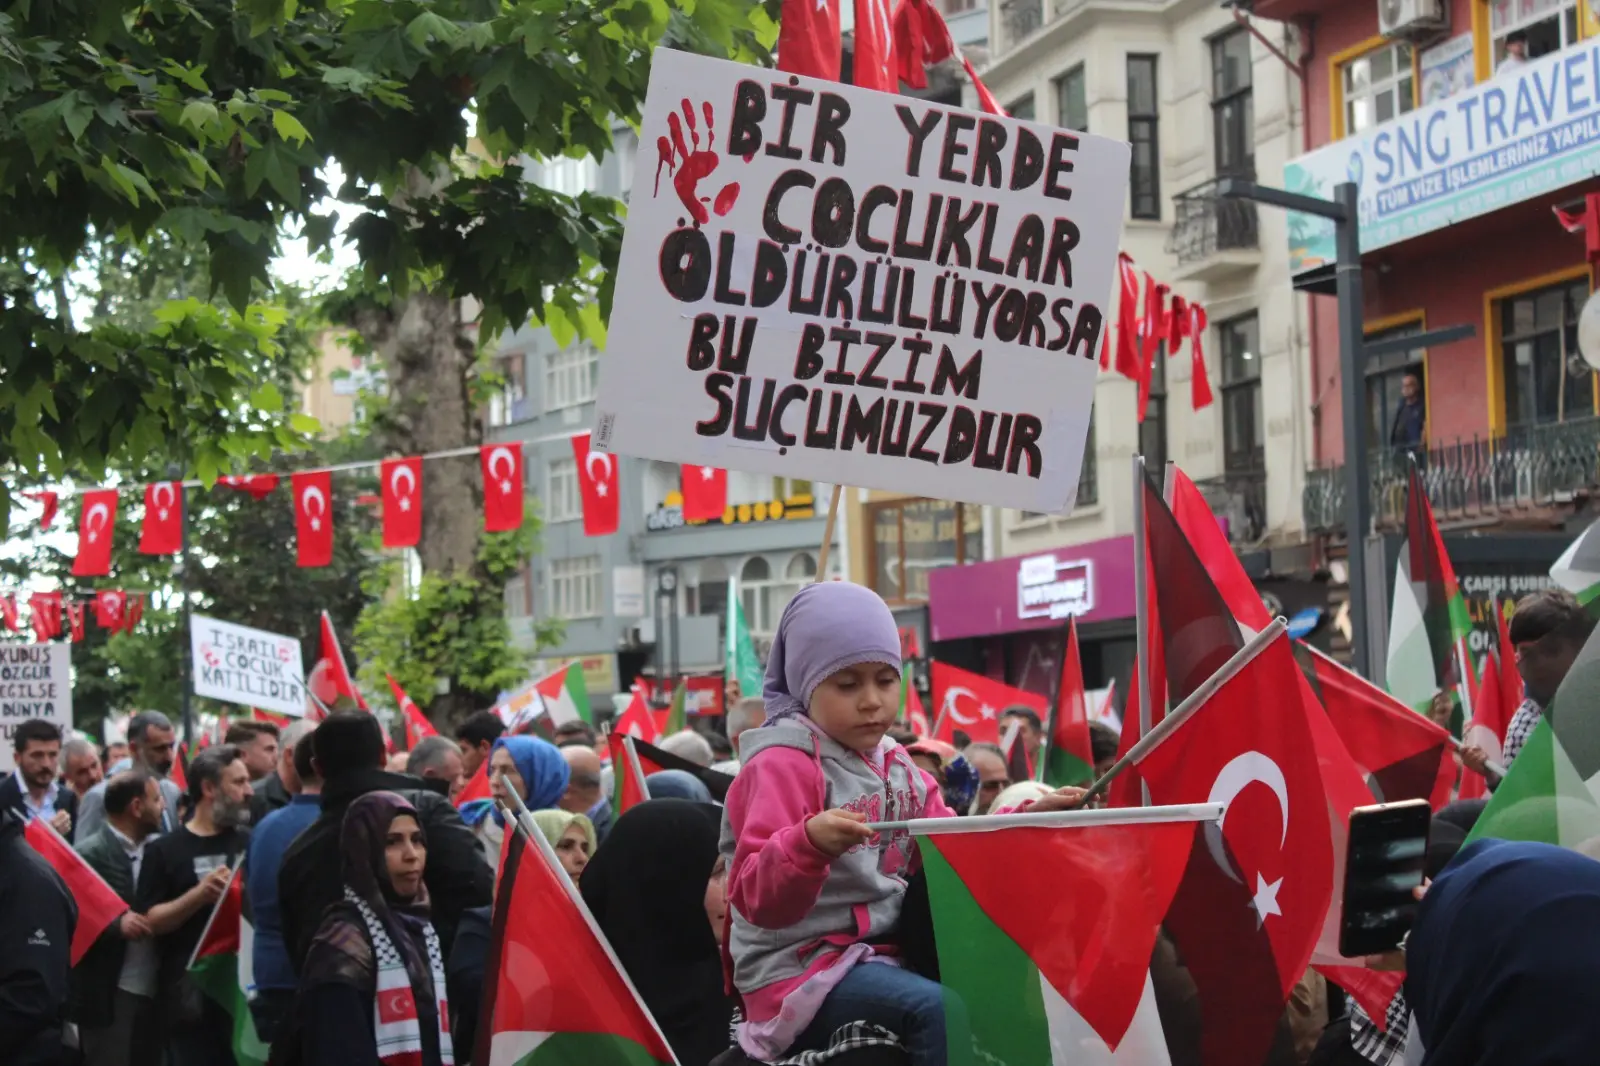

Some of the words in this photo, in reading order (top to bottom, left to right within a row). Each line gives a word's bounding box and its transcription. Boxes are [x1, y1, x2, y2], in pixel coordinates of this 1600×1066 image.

[727, 75, 852, 167] BİR
[894, 104, 1080, 201] YERDE
[1373, 109, 1450, 185] SNG
[1378, 183, 1410, 212] TÜM
[1411, 172, 1445, 204] VİZE
[1446, 136, 1549, 192] İŞLEMLERİNİZ
[658, 215, 1102, 361] ÖLDÜRÜLÜYORSA
[686, 312, 758, 376] BU
[793, 320, 983, 400] BİZİM
[695, 371, 1043, 480] SUÇUMUZDUR
